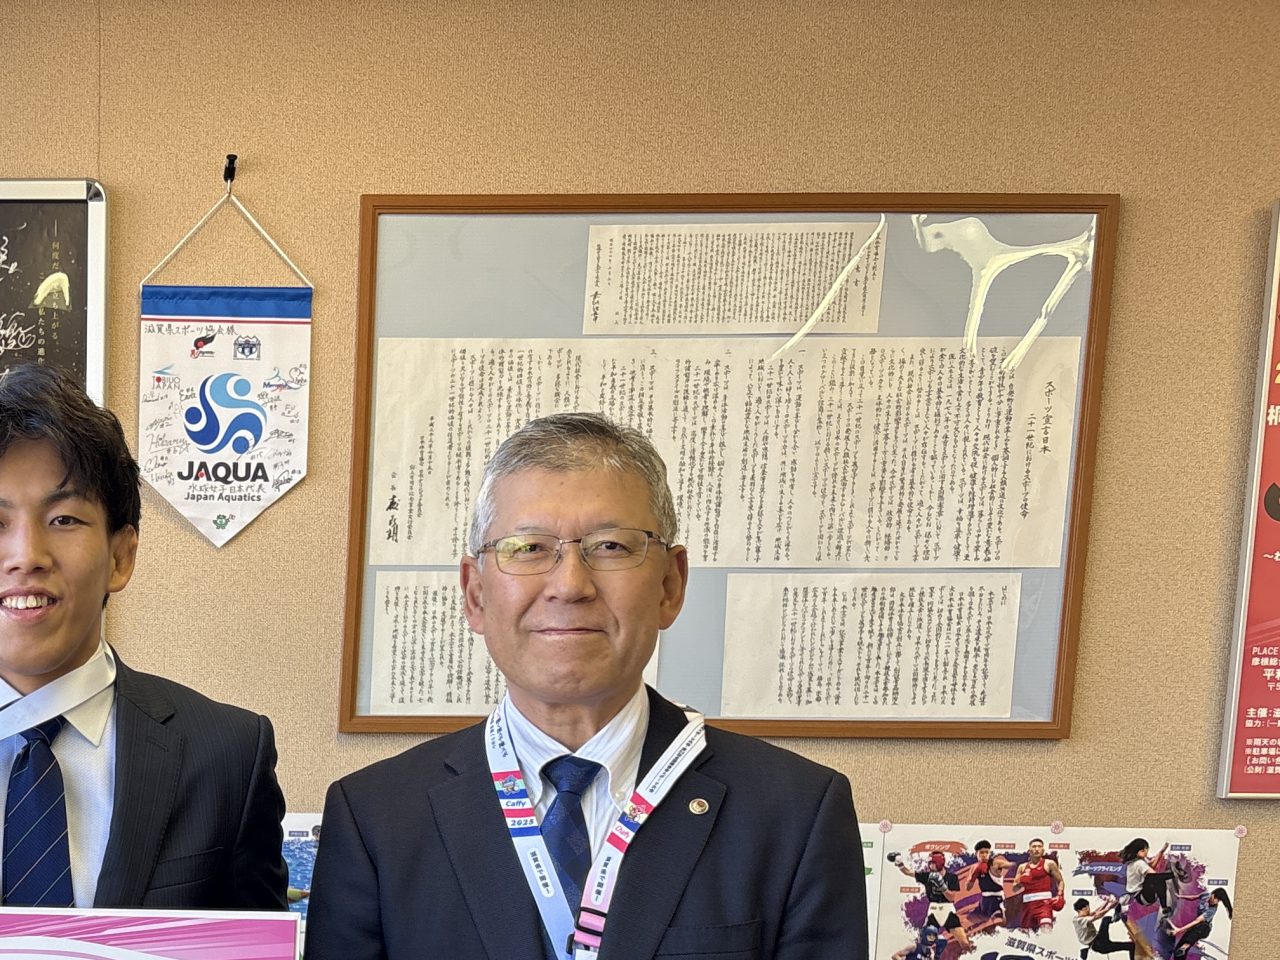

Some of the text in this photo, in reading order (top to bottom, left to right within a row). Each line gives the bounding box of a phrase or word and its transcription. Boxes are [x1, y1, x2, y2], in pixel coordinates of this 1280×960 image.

[177, 460, 270, 485] JAQUA
[184, 491, 262, 504] Japan Aquatics
[1251, 646, 1280, 656] PLACE
[1250, 656, 1280, 666] 彦根総
[505, 800, 527, 809] Caffy
[509, 818, 535, 827] 2025
